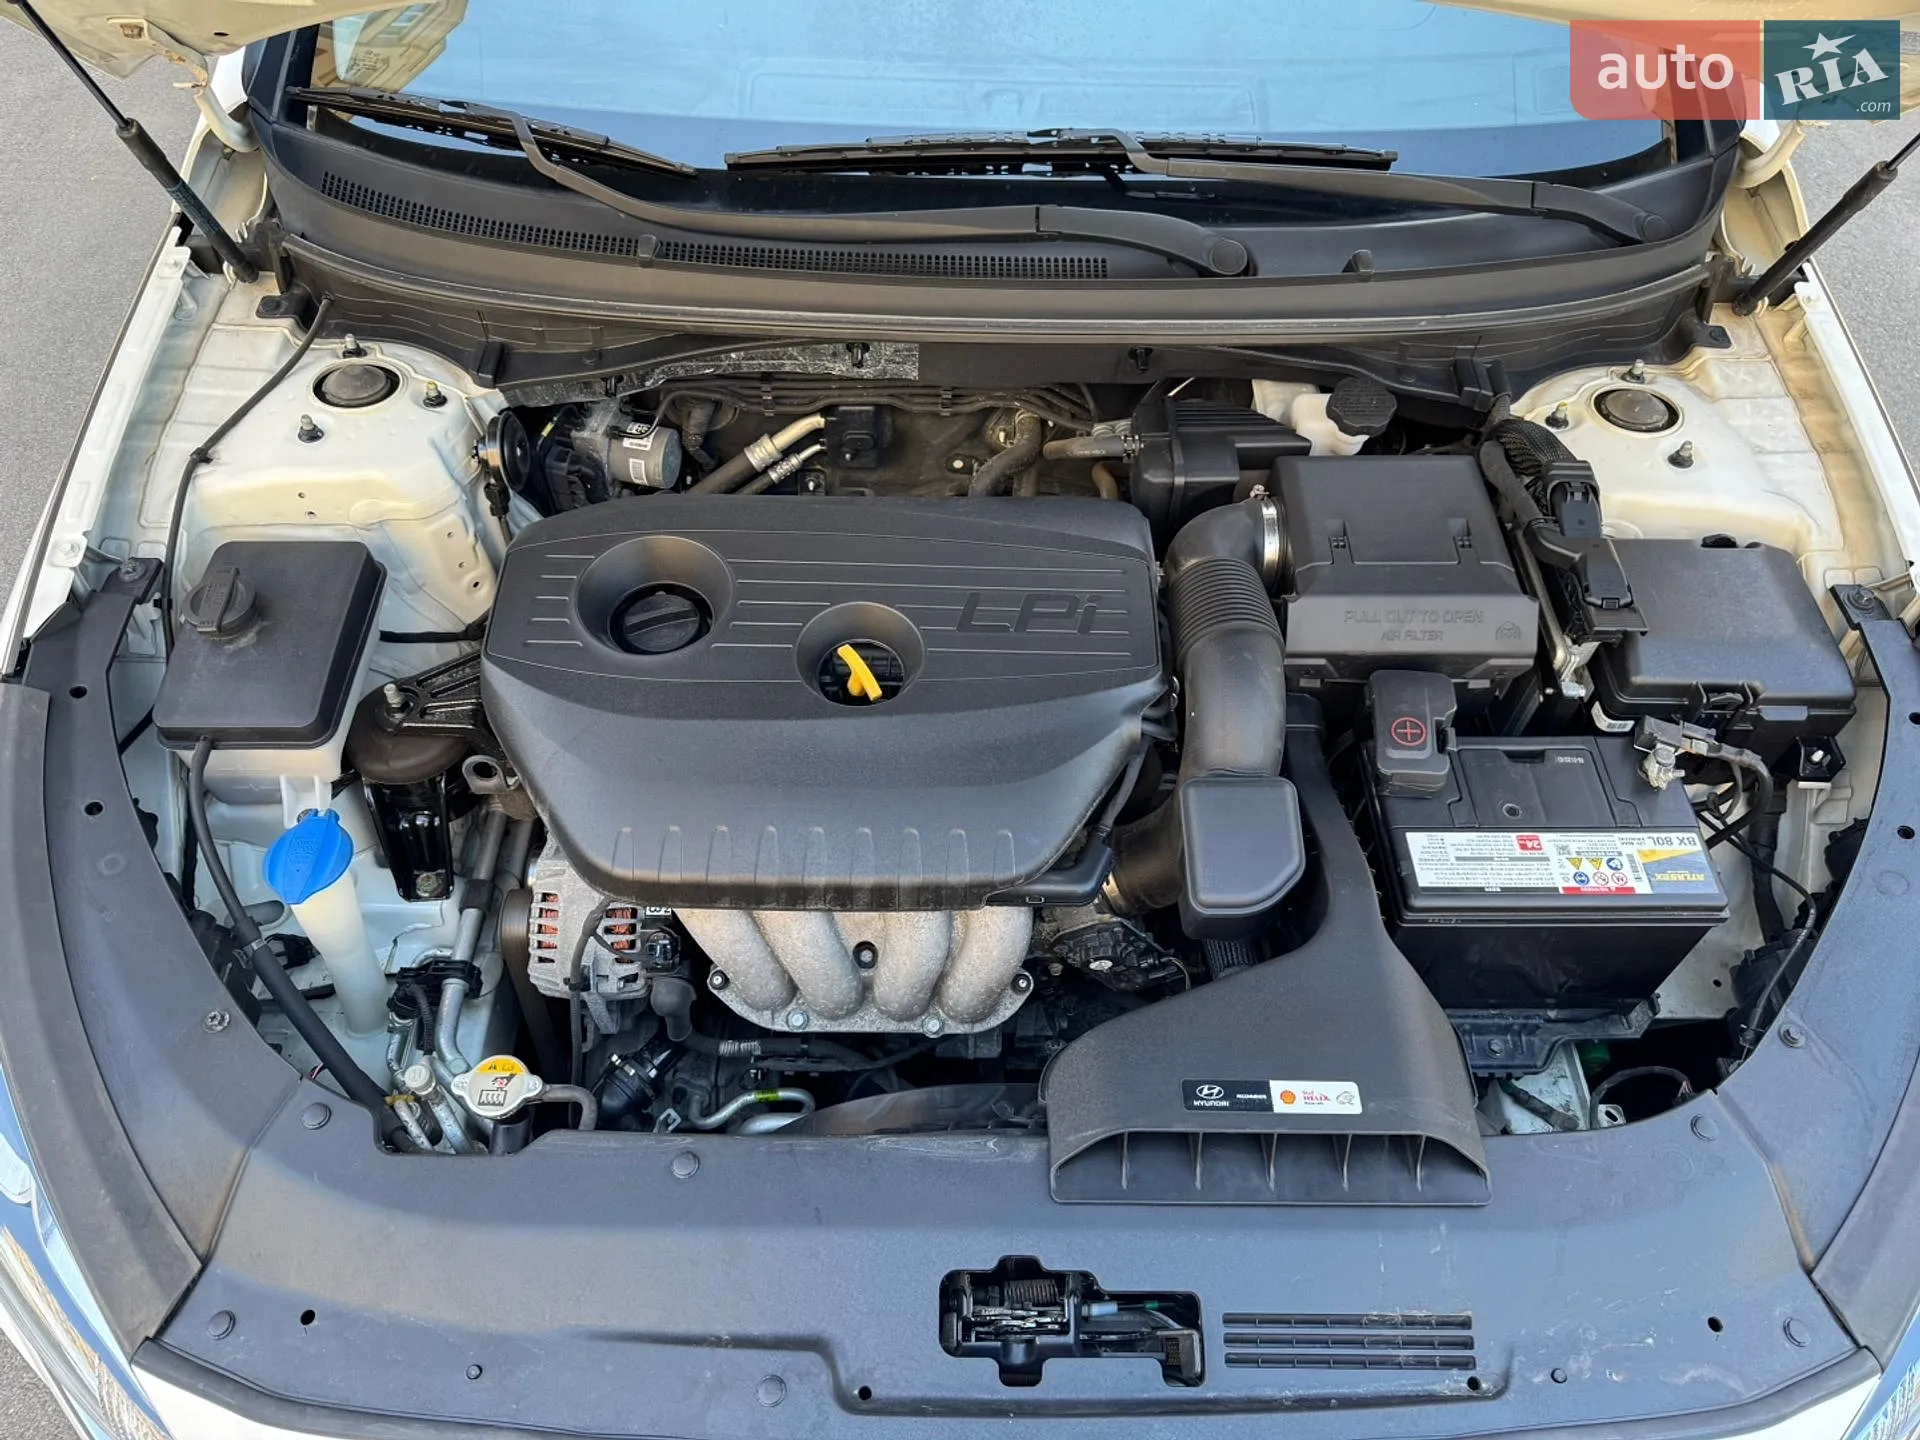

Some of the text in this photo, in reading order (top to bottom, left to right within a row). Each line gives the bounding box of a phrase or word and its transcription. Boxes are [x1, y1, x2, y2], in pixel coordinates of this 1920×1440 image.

[1343, 610, 1483, 624] PULL OUT TO OPEN
[1380, 630, 1443, 642] AIR FILTER
[1676, 836, 1697, 847] BX
[1193, 1099, 1229, 1107] HYUNDAI
